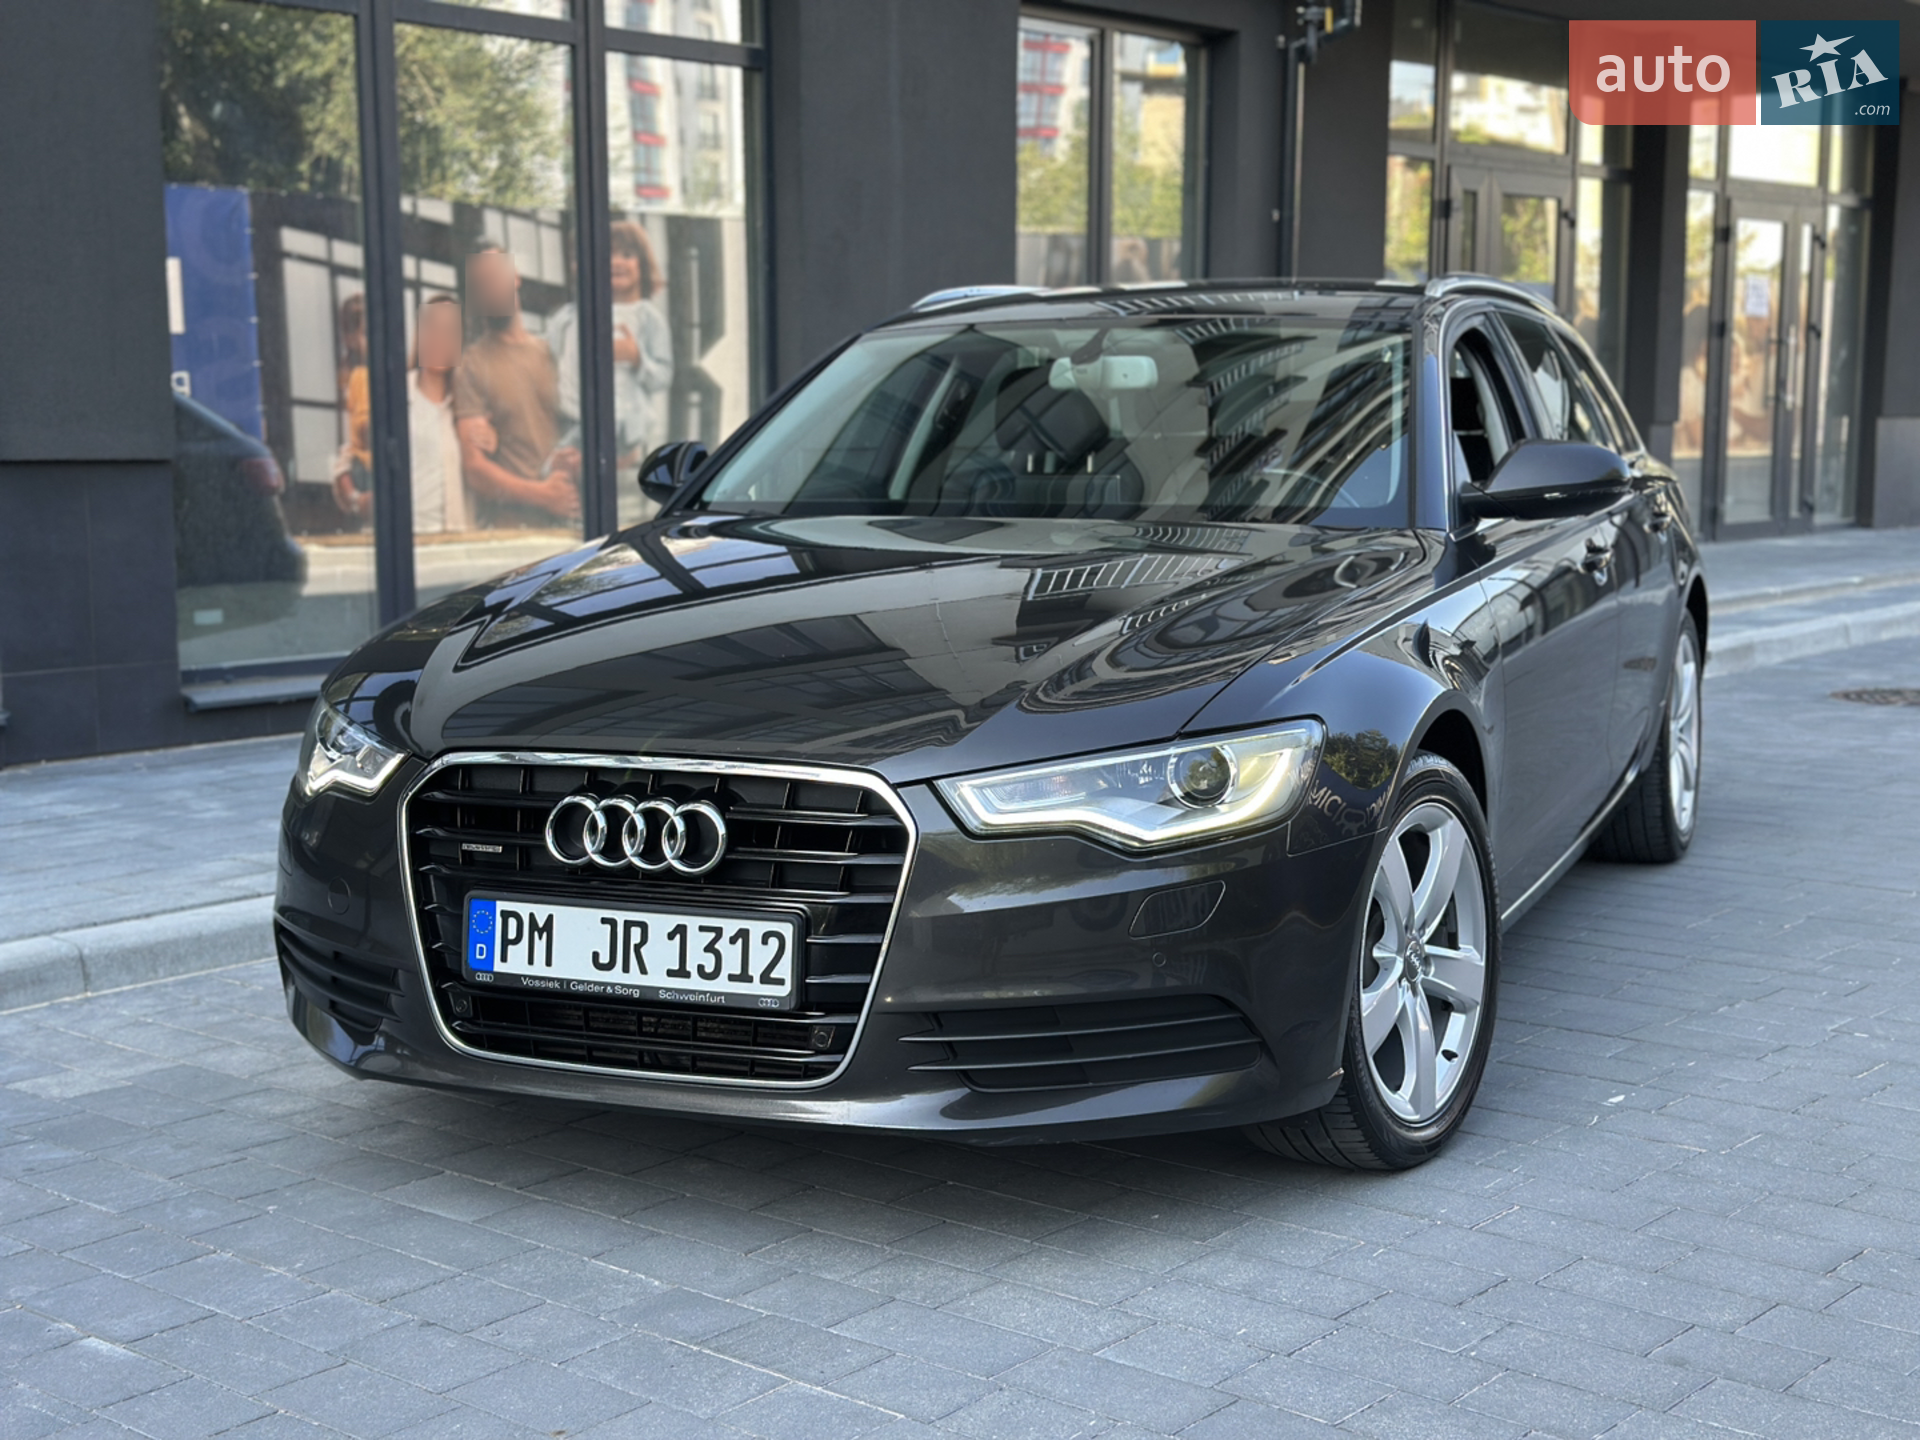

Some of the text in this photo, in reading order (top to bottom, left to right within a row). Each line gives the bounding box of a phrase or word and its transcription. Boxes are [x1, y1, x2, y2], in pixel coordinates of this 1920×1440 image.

[475, 943, 487, 959] D
[500, 909, 786, 986] PM JR 1312
[570, 980, 604, 993] Gelder
[606, 985, 613, 994] &
[614, 984, 640, 998] Sorg
[658, 989, 725, 1004] Schweinfurt
